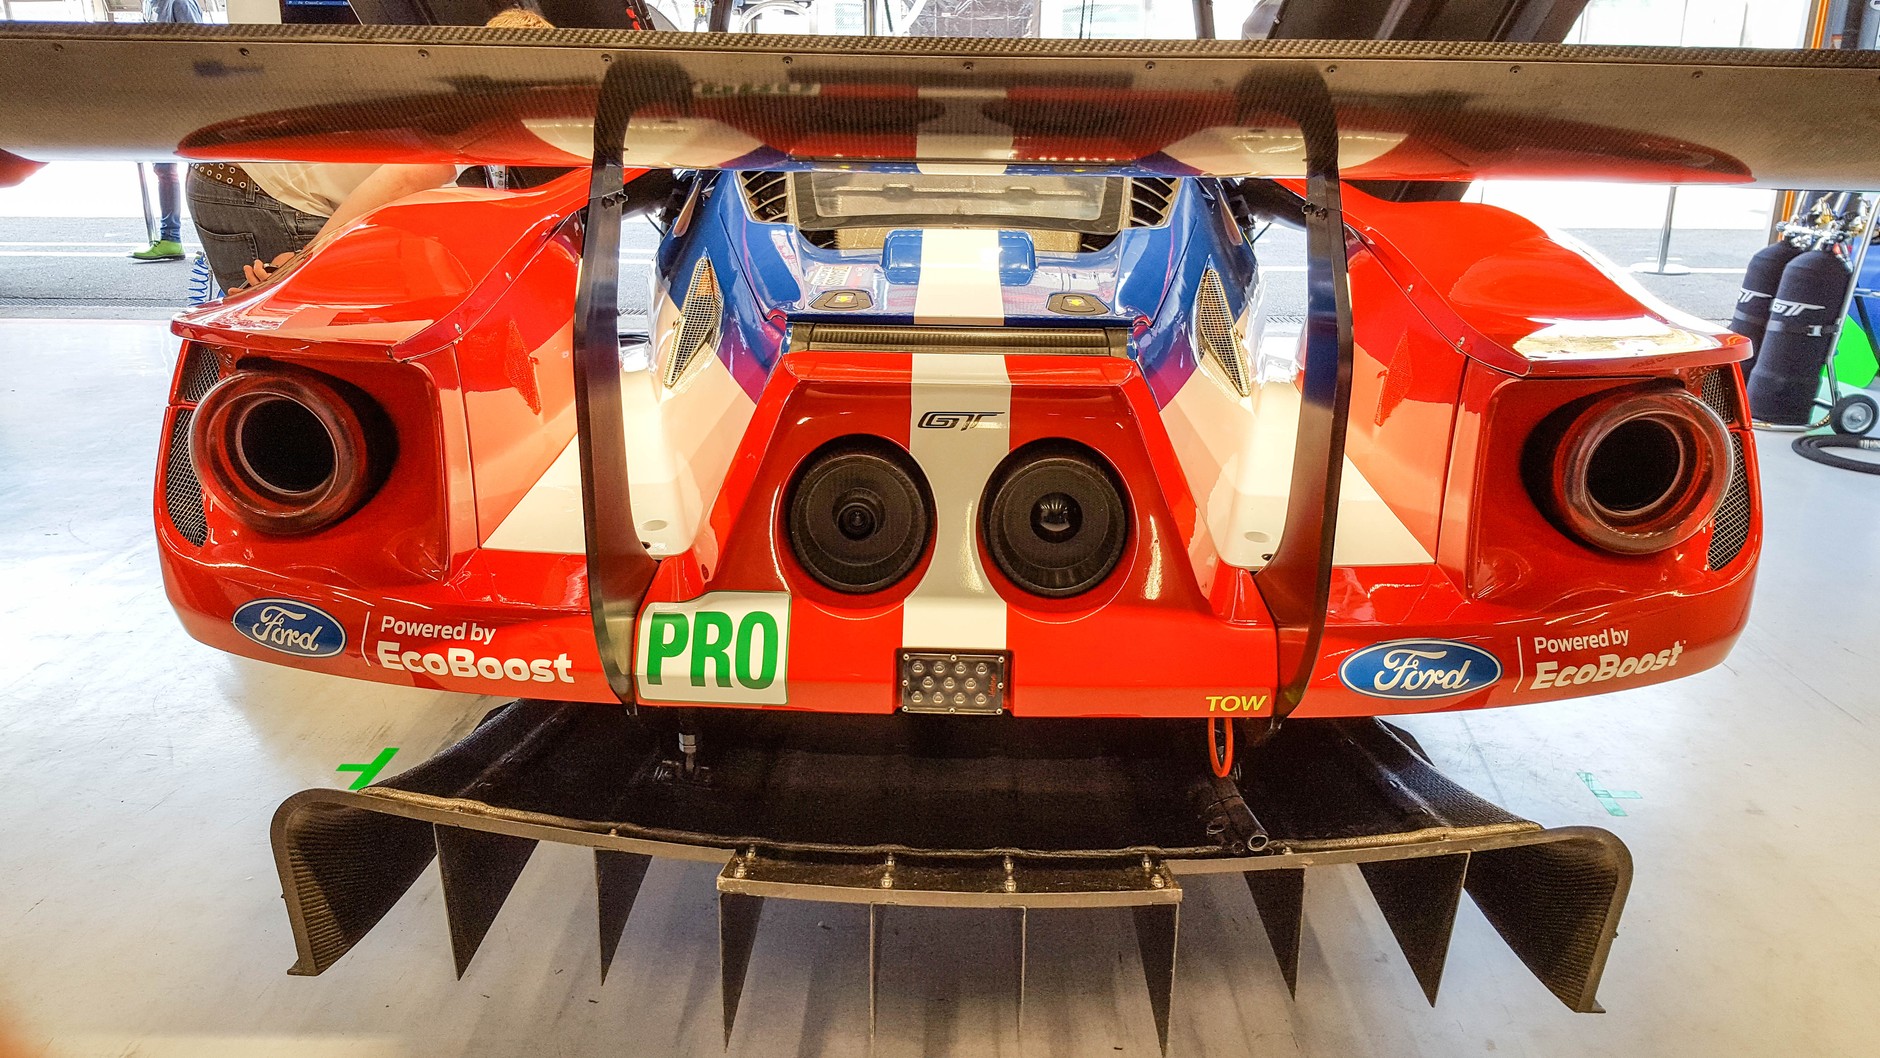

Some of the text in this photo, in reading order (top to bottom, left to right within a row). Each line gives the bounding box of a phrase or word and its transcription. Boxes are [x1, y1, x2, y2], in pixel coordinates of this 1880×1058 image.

[1771, 298, 1826, 317] GT
[917, 411, 1006, 432] GT
[252, 605, 322, 652] Ford
[380, 615, 497, 645] Powered by
[1534, 627, 1629, 654] Powered by
[376, 641, 576, 684] EcoBoost
[646, 611, 779, 690] PRO
[1529, 640, 1684, 690] EcoBoost
[1373, 648, 1472, 692] Ford
[1205, 695, 1268, 712] TOW
